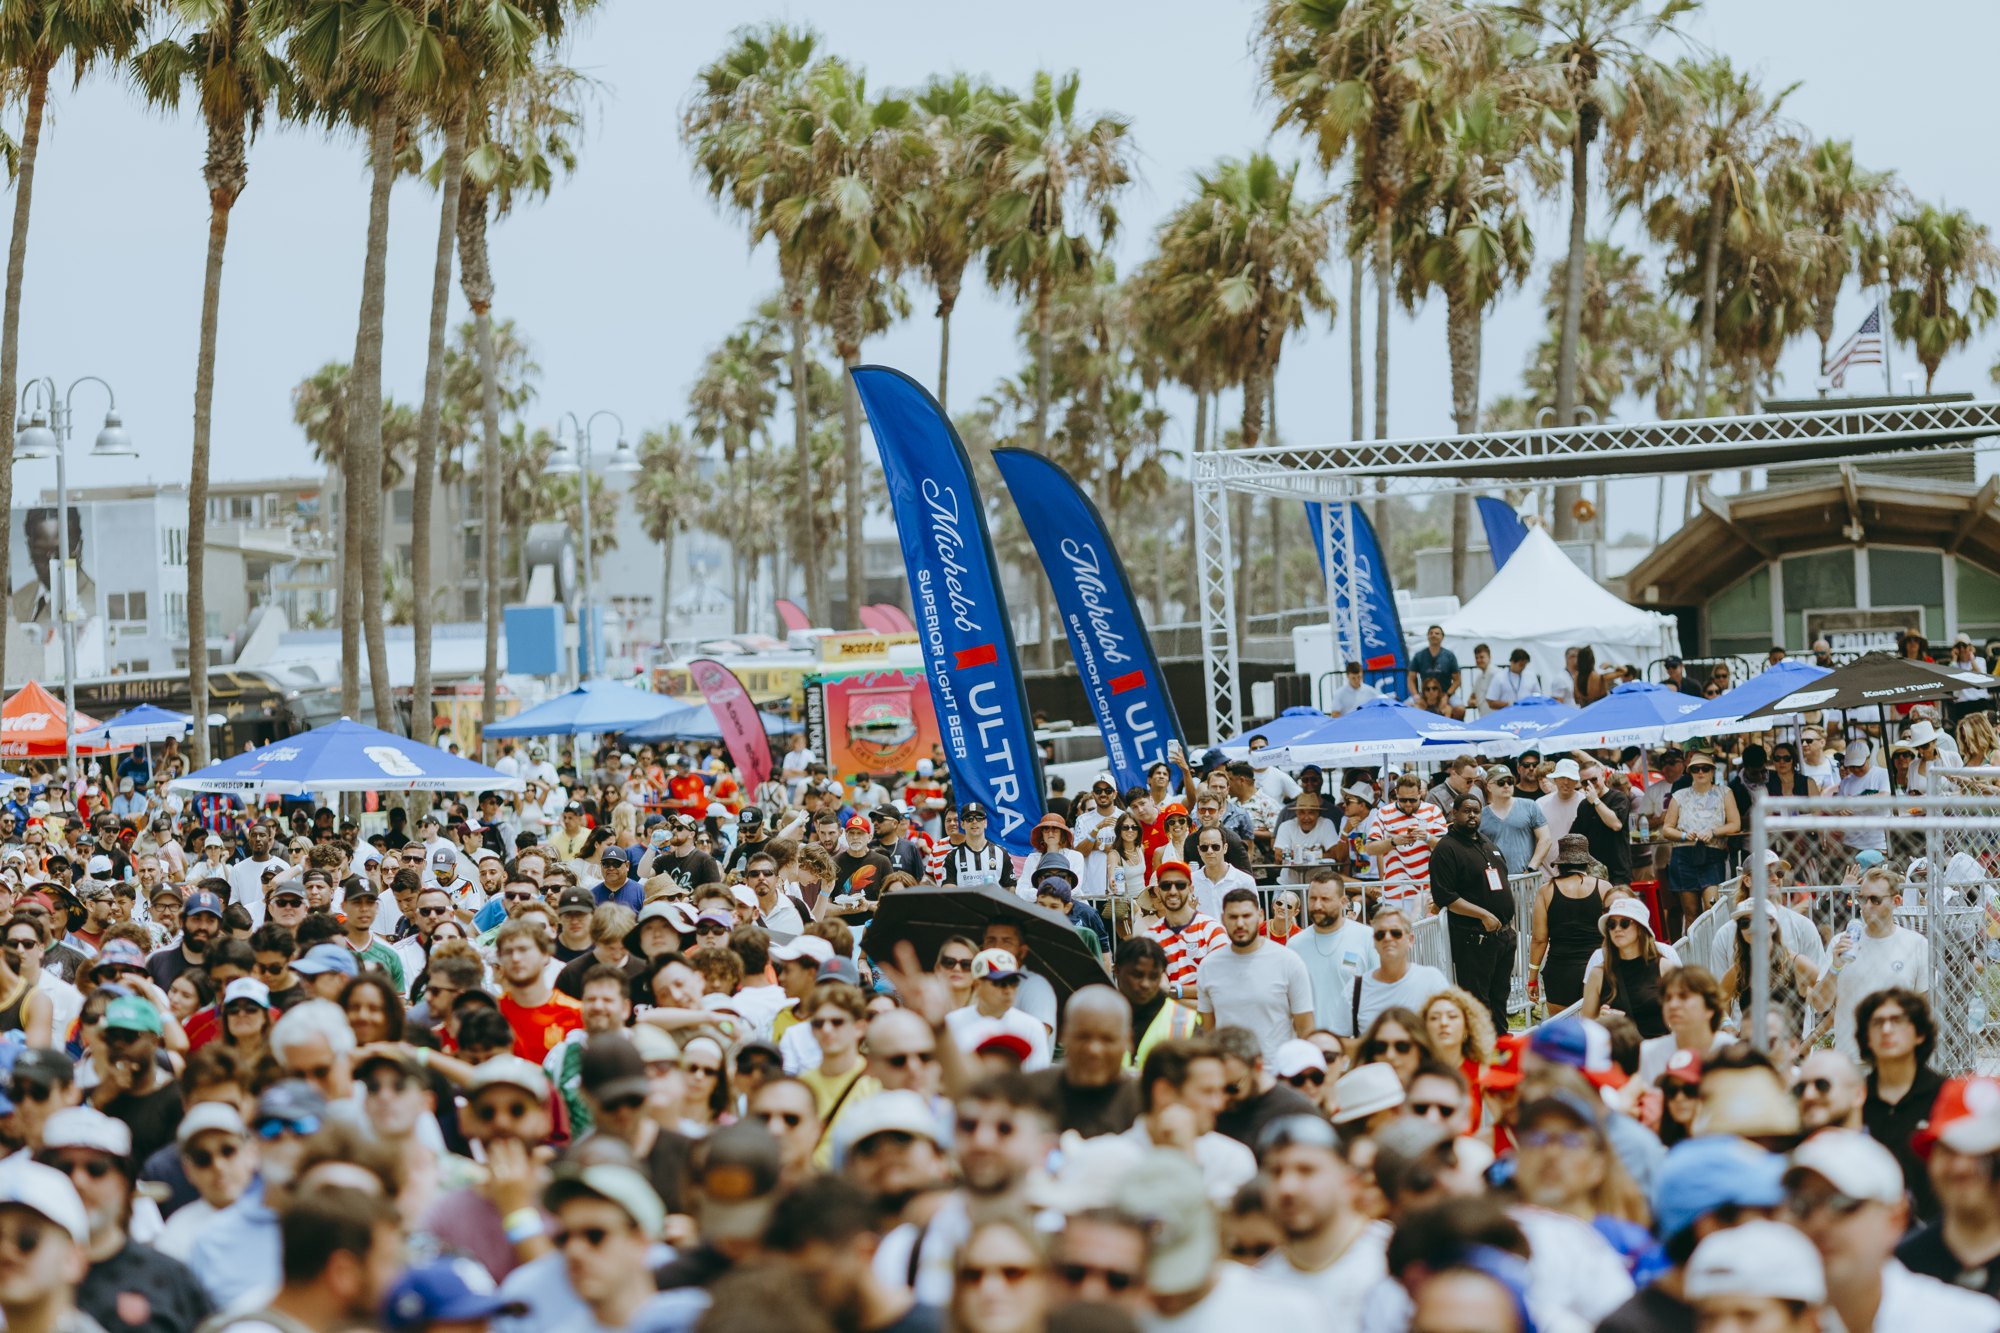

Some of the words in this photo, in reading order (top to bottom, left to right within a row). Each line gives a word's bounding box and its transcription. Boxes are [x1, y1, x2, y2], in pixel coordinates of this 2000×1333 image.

[922, 478, 982, 632] Michelob
[1061, 538, 1132, 663] Michelob
[101, 683, 120, 701] LOS
[125, 680, 169, 700] ANGELES
[918, 569, 944, 656] SUPERIOR
[934, 660, 957, 711] LIGHT
[948, 714, 967, 759] BEER
[1069, 614, 1101, 686] SUPERIOR
[1095, 687, 1116, 730] LIGHT
[1108, 732, 1127, 771] BEER
[1862, 689, 1894, 698] Keep
[1894, 687, 1906, 695] It
[969, 681, 1026, 838] ULTRA
[1126, 701, 1168, 772] ULT
[1362, 743, 1395, 752] ULTRA
[1608, 734, 1640, 744] ULTRA
